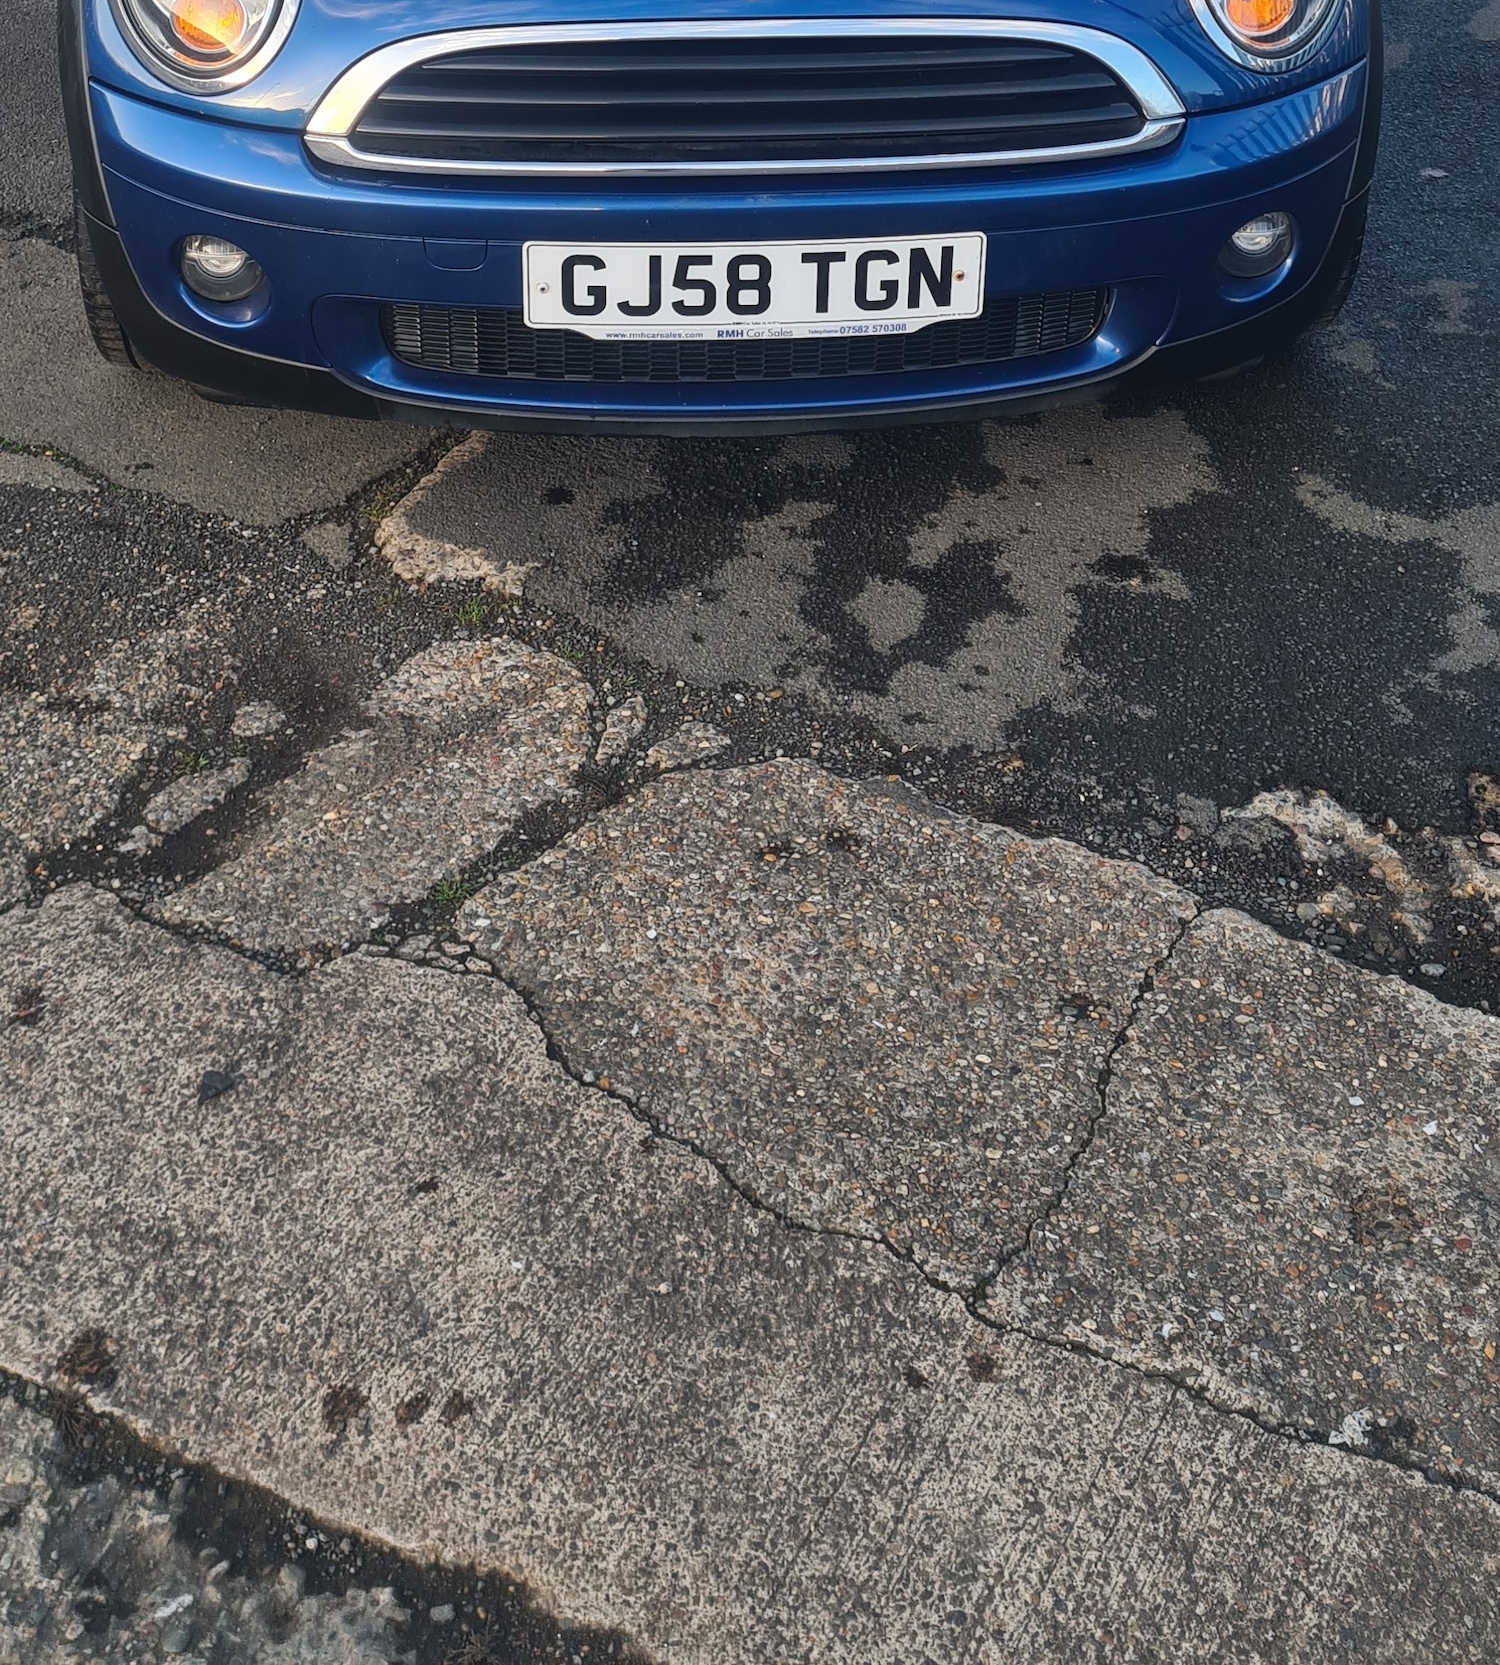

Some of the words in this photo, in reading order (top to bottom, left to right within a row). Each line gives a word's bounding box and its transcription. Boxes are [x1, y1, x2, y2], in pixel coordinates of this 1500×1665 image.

[560, 254, 773, 317] GJ58
[800, 246, 955, 314] TGN
[717, 329, 744, 338] RMH
[746, 329, 765, 338] Car
[767, 327, 794, 338] Sales
[840, 325, 870, 334] 07582
[872, 323, 907, 333] 570308
